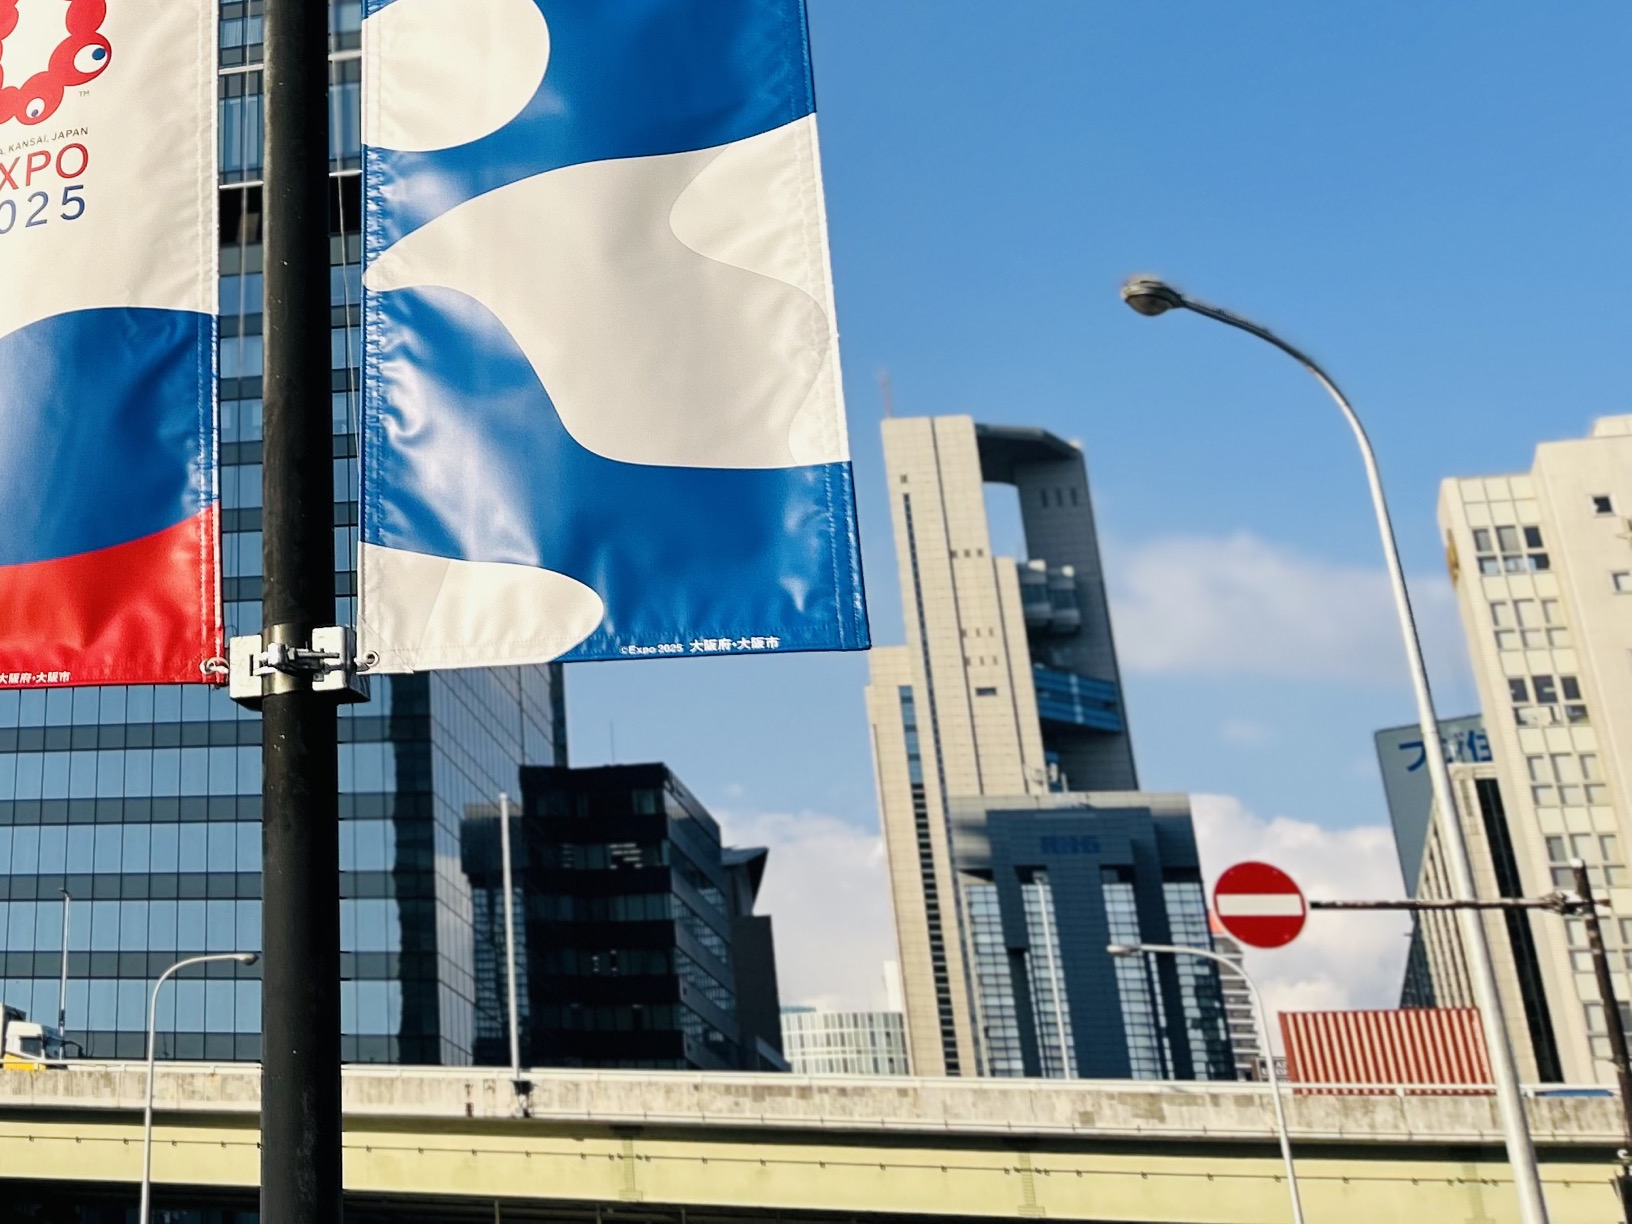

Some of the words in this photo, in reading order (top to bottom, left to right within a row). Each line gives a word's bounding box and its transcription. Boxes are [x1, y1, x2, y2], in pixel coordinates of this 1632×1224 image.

[8, 135, 49, 153] KANSAI,
[52, 127, 88, 141] JAPAN
[658, 643, 684, 654] 2025
